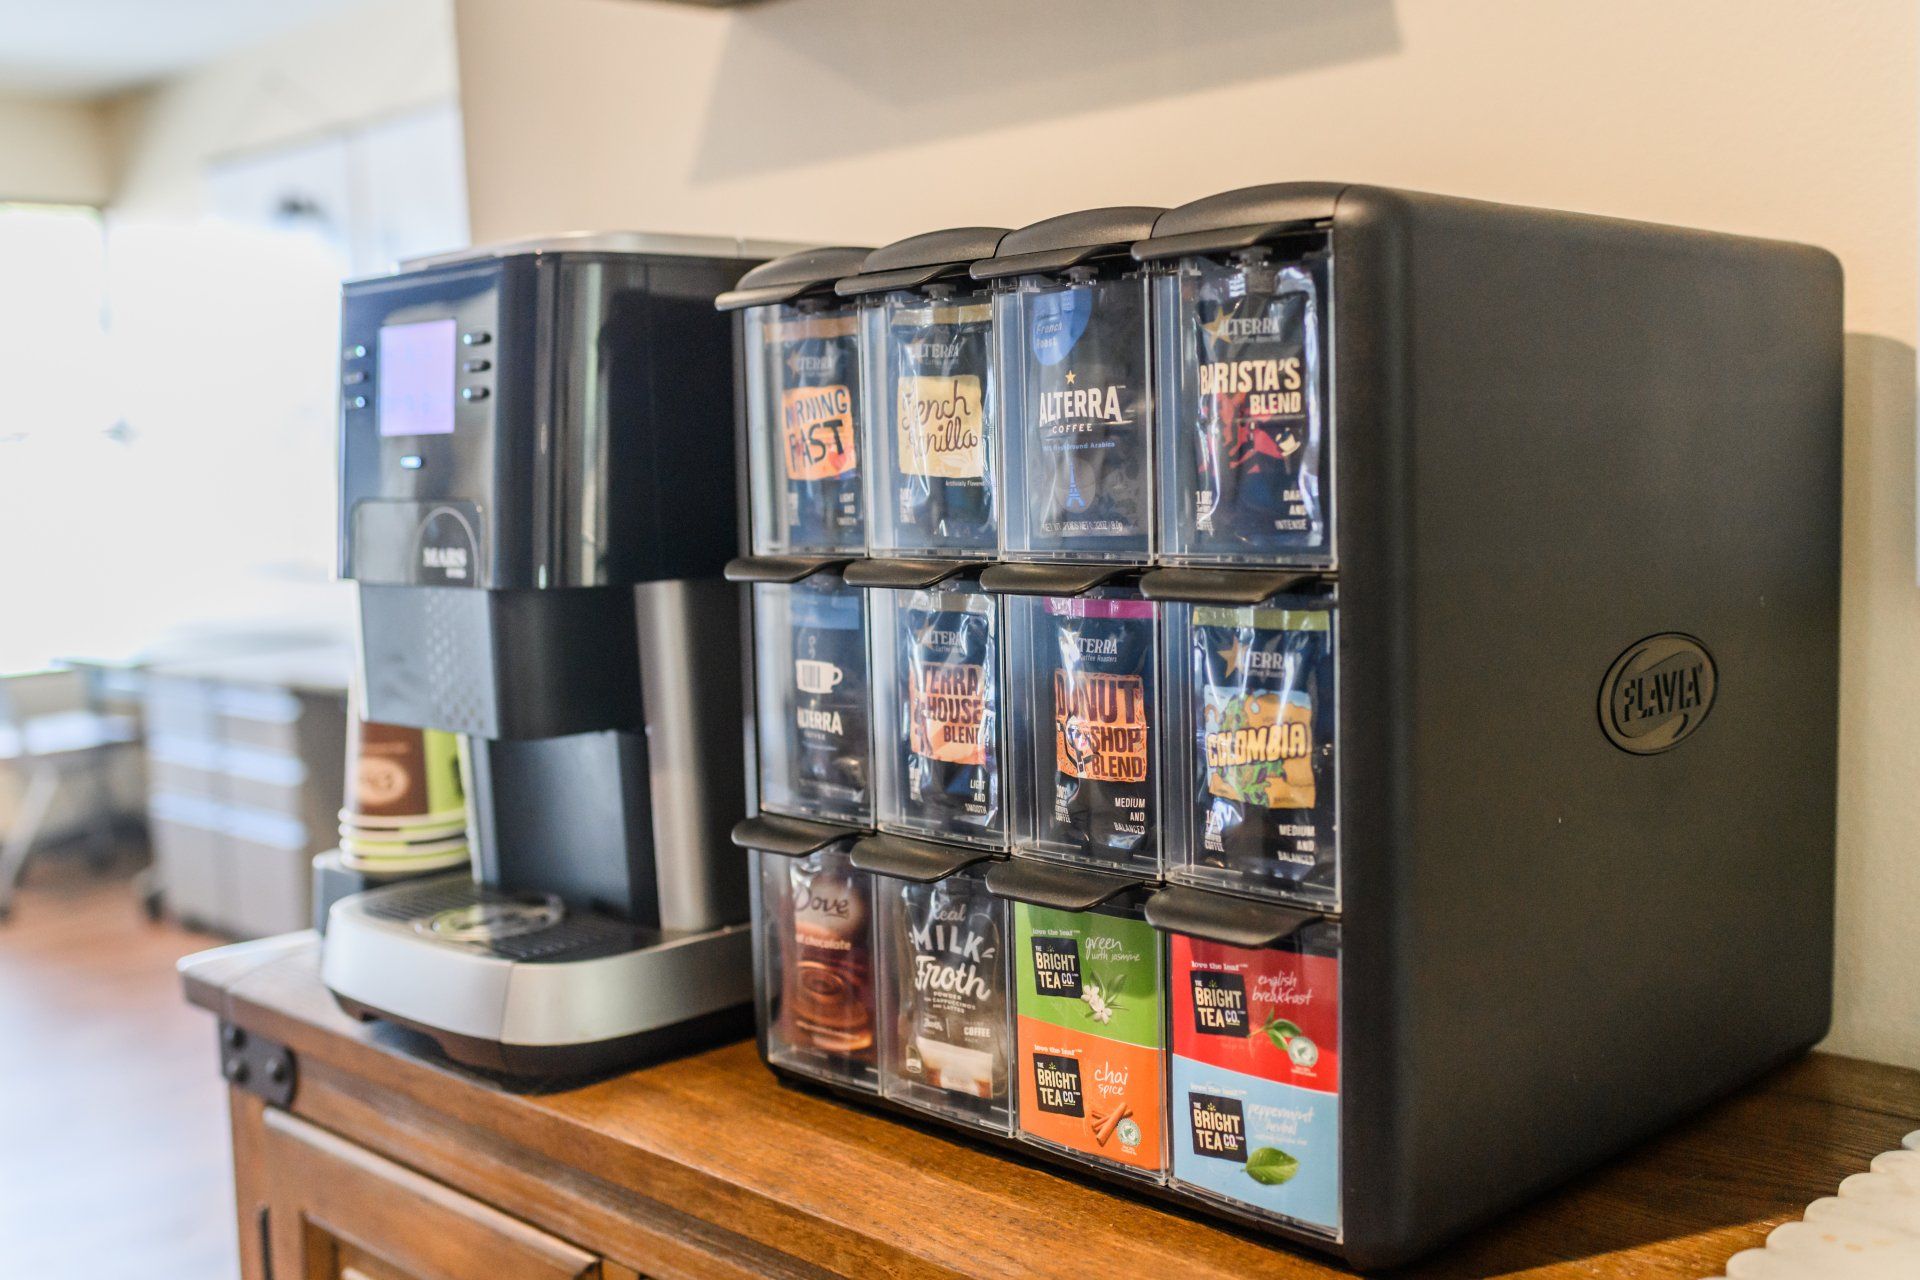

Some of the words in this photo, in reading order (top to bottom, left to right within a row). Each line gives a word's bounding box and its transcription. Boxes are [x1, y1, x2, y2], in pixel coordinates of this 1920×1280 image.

[1040, 386, 1122, 428] ALTERRA
[1250, 391, 1301, 415] BLEND
[1052, 423, 1093, 434] COFFEE
[1078, 638, 1118, 655] TERRA
[1622, 664, 1702, 723] FLAVIA
[1090, 726, 1140, 754] SHOP
[1206, 722, 1306, 768] COLOMBIA
[1091, 756, 1142, 778] BLEND
[974, 793, 986, 803] AND
[1114, 797, 1146, 808] MEDIUM
[1130, 811, 1145, 822] AND
[1113, 822, 1146, 835] BALANCED
[1279, 824, 1315, 837] MEDIUM
[1296, 840, 1315, 851] AND
[1033, 928, 1046, 936] love
[911, 923, 984, 963] MILK
[1085, 936, 1122, 960] green
[1036, 952, 1076, 972] BRIGHT
[1092, 951, 1108, 960] with
[1191, 961, 1208, 969] love
[1209, 962, 1222, 970] the
[915, 955, 991, 1000] Froth
[1038, 971, 1061, 989] TEA
[1061, 972, 1074, 985] CO.
[1257, 970, 1298, 990] english
[1195, 987, 1242, 1009] BRIGHT
[1252, 986, 1313, 1006] breakfast
[1198, 1008, 1225, 1028] TEA
[1225, 1010, 1240, 1024] CO.
[963, 1026, 991, 1038] COFFEE
[1034, 1045, 1049, 1053] love
[1037, 1069, 1077, 1090] BRIGHT
[1094, 1060, 1128, 1085] chai
[1040, 1087, 1063, 1107] TEA
[1063, 1091, 1076, 1104] CO.
[1098, 1083, 1124, 1098] spice
[1193, 1108, 1240, 1133] BRIGHT
[1196, 1129, 1223, 1151] TEA
[1223, 1133, 1239, 1148] CO.
